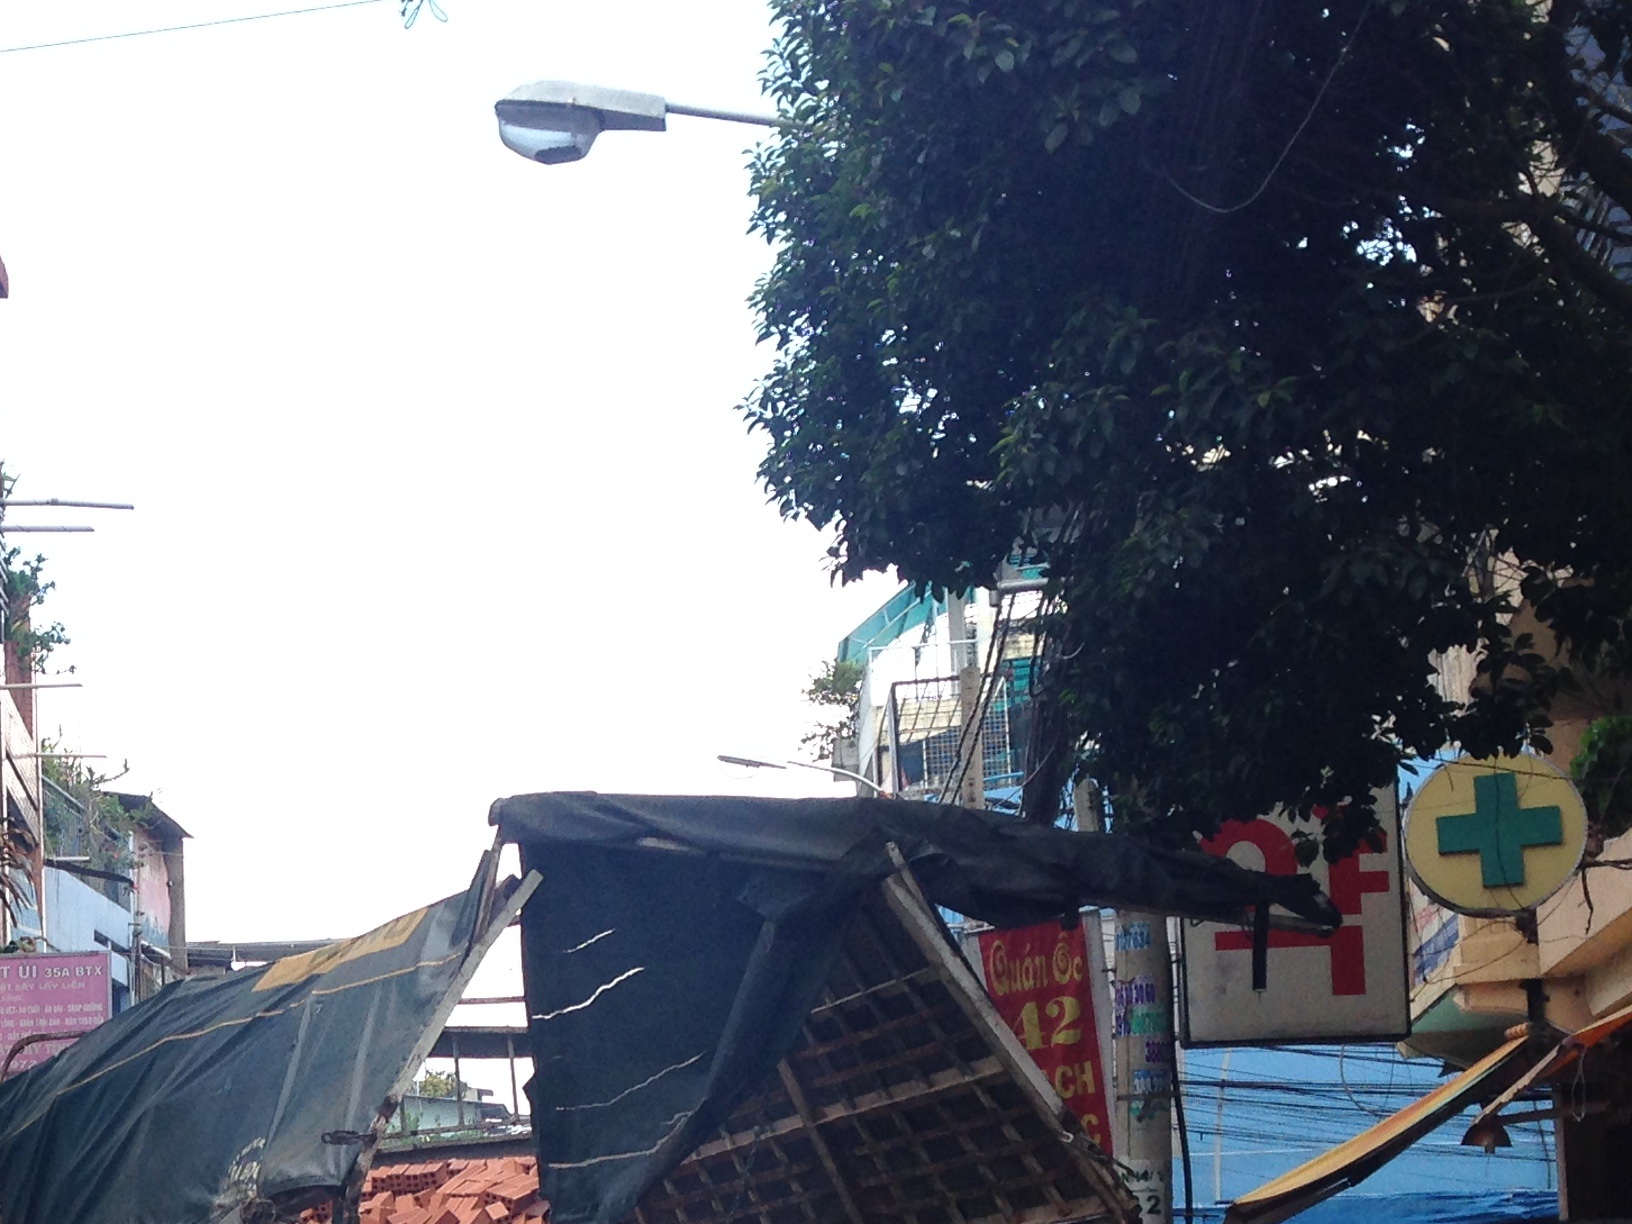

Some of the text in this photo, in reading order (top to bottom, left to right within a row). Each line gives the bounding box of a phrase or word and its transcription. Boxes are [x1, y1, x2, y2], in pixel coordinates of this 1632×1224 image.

[44, 967, 70, 978] 35A
[75, 965, 103, 977] BTX
[1012, 996, 1082, 1050] 42
